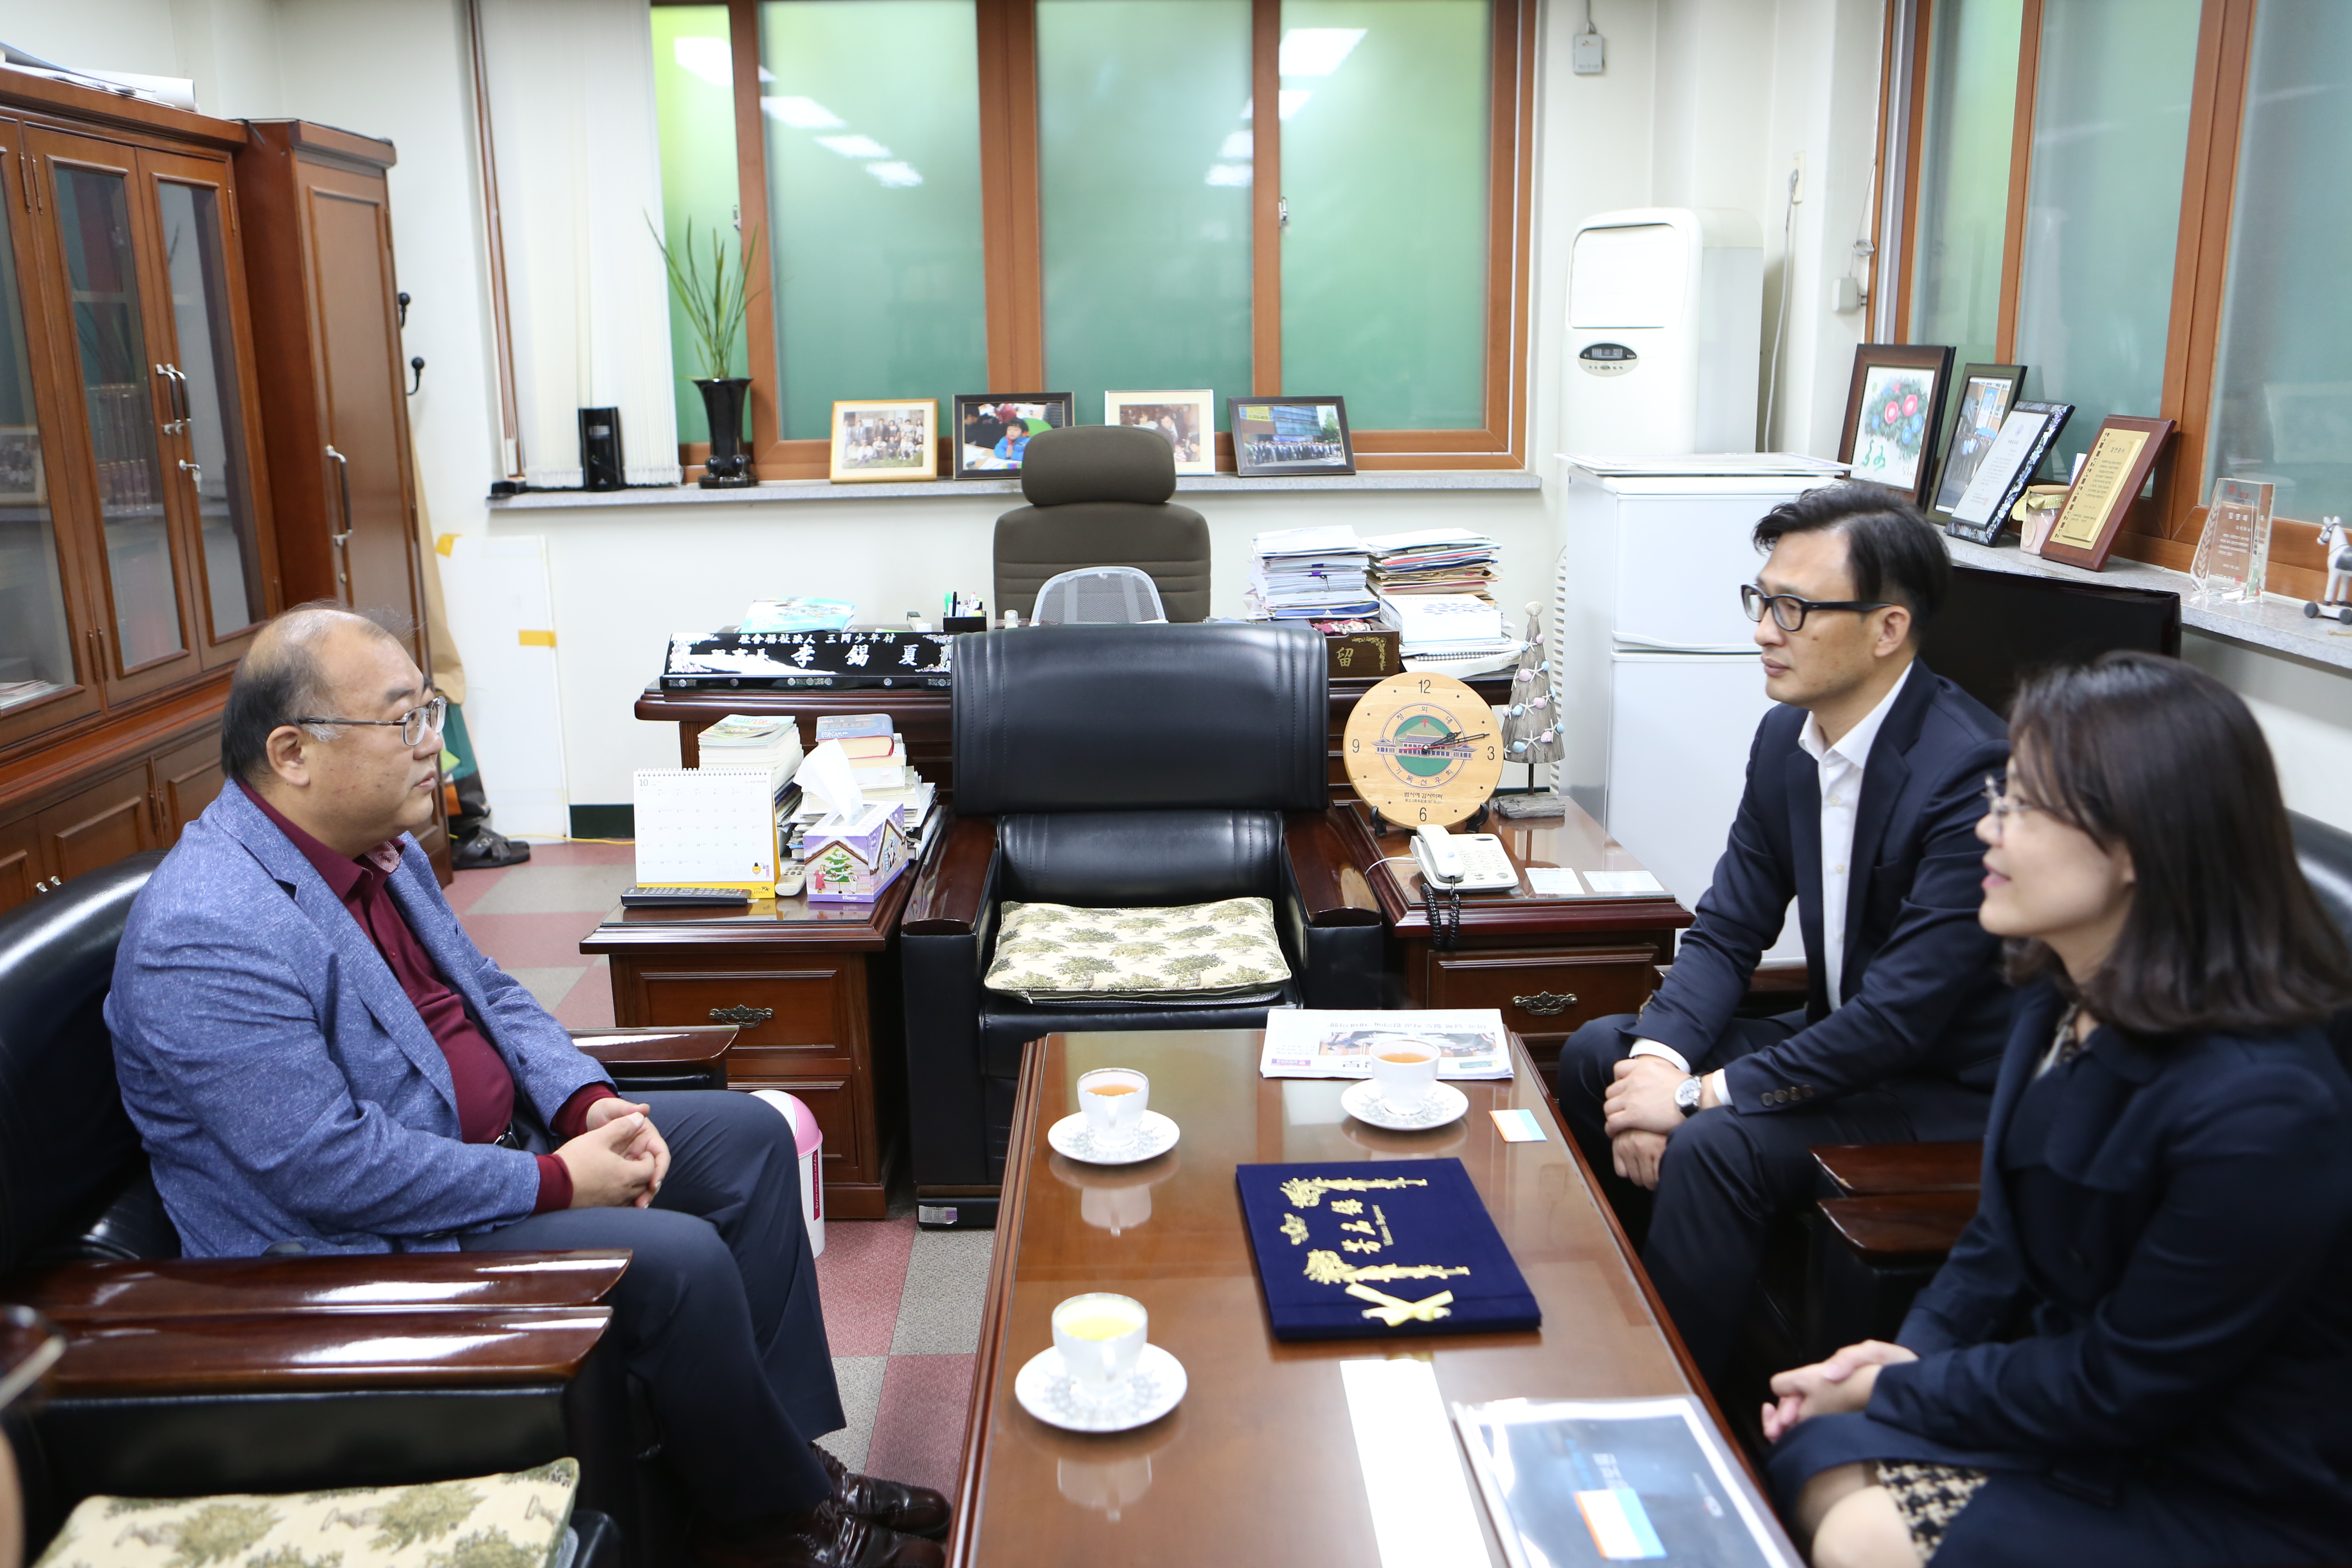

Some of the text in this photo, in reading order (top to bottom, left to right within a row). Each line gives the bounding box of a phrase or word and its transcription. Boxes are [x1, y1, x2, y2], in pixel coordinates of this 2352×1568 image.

[738, 633, 896, 645] 社會福祉法人 三同少年村
[1336, 646, 1354, 667] 留
[1418, 679, 1431, 694] 12
[1352, 739, 1360, 753] 9
[1487, 746, 1495, 761] 3
[1419, 807, 1428, 822] 6
